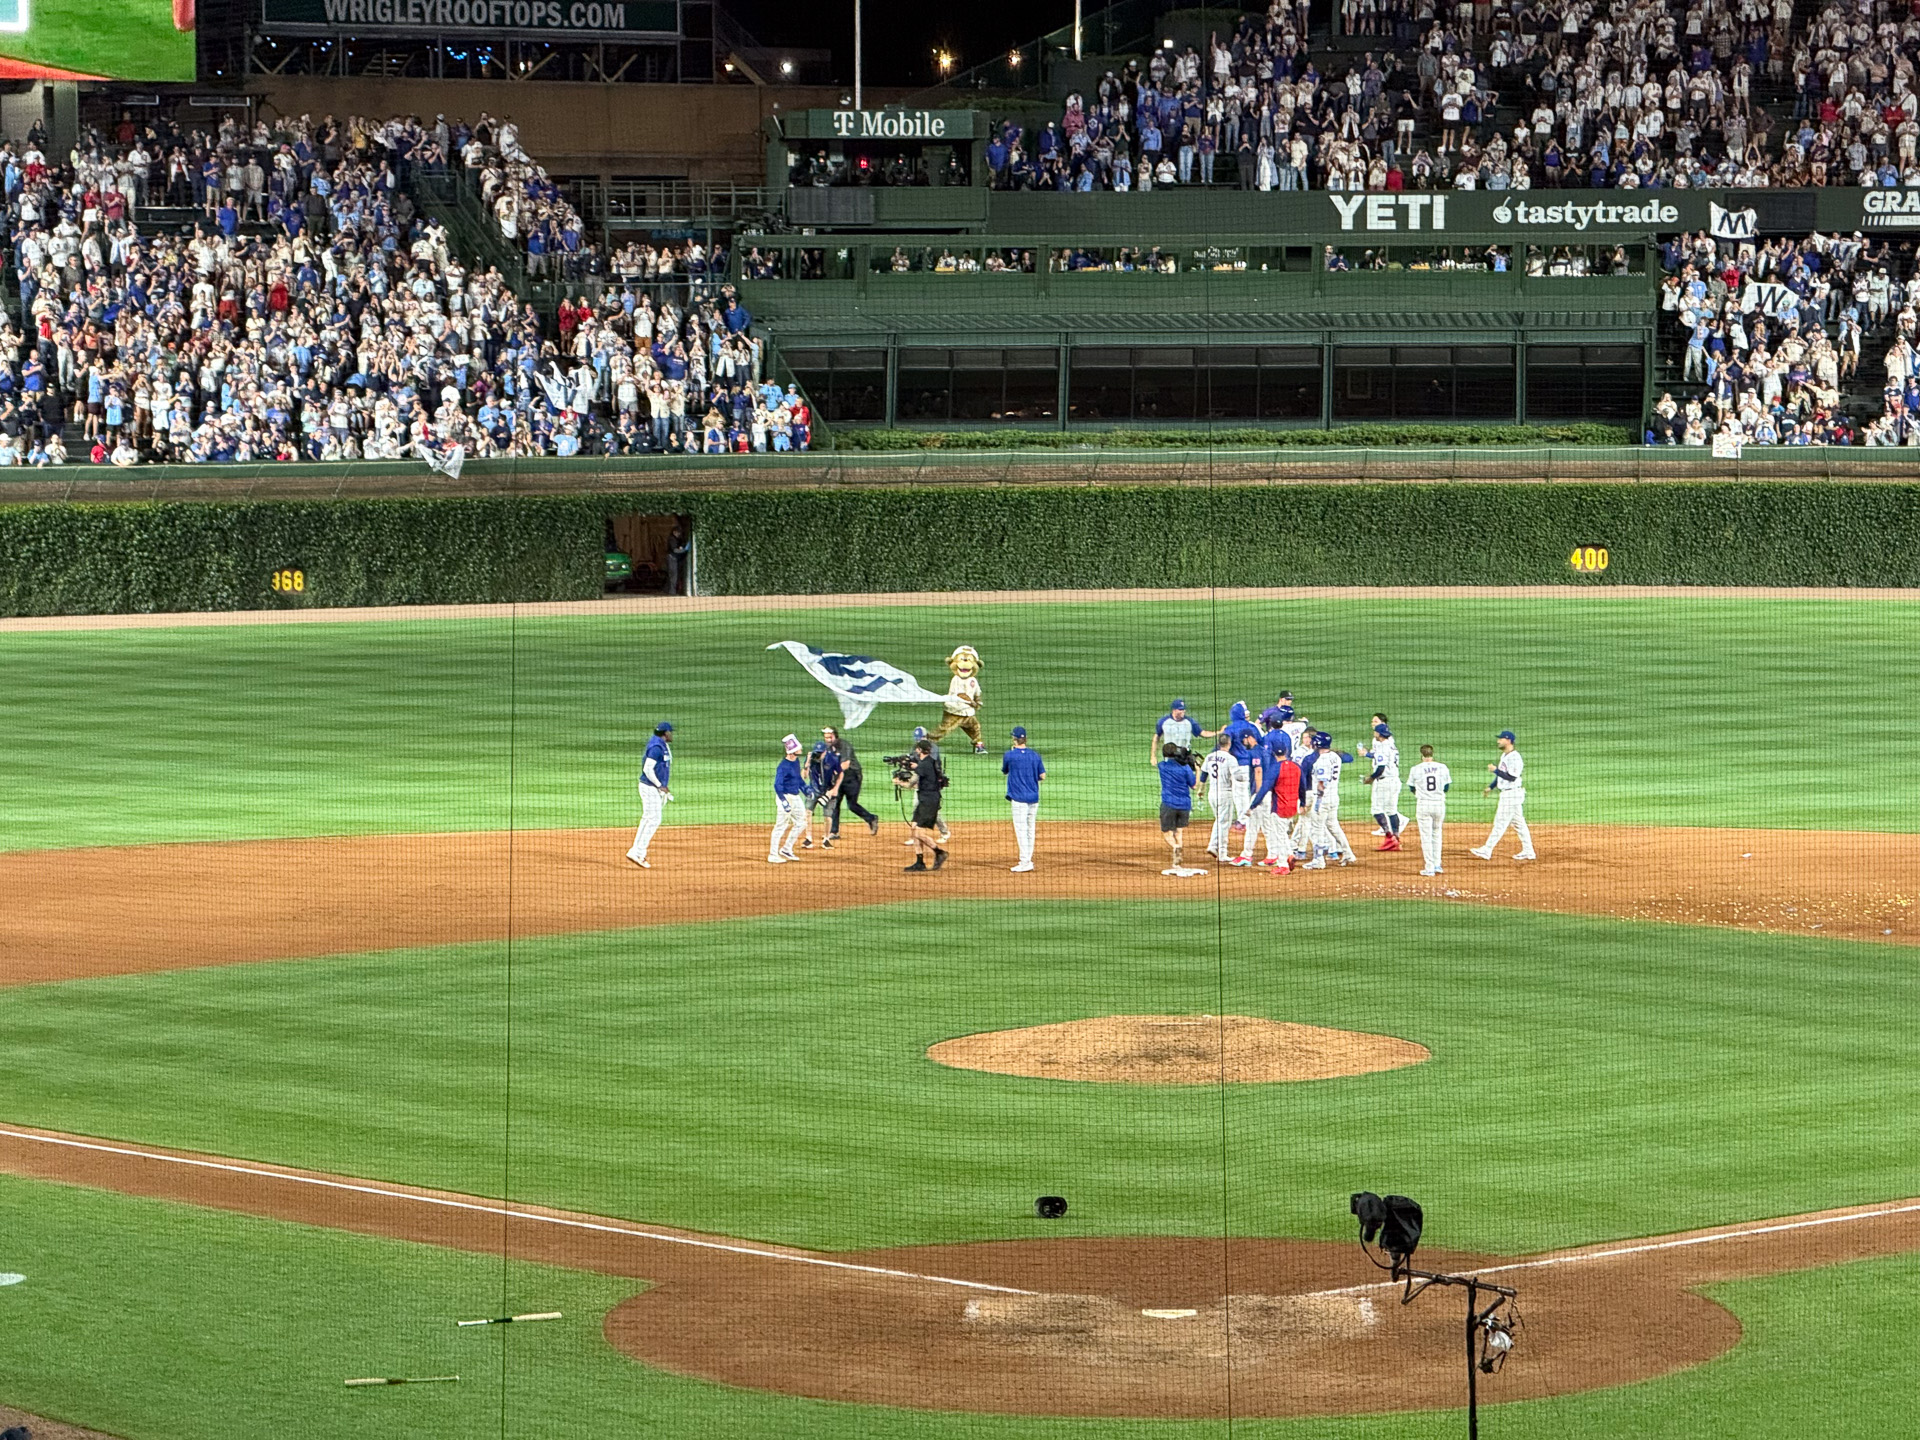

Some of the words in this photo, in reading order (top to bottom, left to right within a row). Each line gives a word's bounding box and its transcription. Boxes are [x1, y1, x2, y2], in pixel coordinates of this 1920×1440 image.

[323, 0, 626, 28] WRIGLEYROOFTOPS.COM
[860, 111, 945, 137] Mobile
[1329, 195, 1445, 230] YETI
[1863, 191, 1920, 213] GRA
[1515, 199, 1679, 230] tastytrade
[1757, 285, 1788, 313] W
[1571, 548, 1609, 570] 400
[271, 570, 304, 592] 368
[1211, 763, 1219, 779] 3
[1426, 775, 1436, 791] 8
